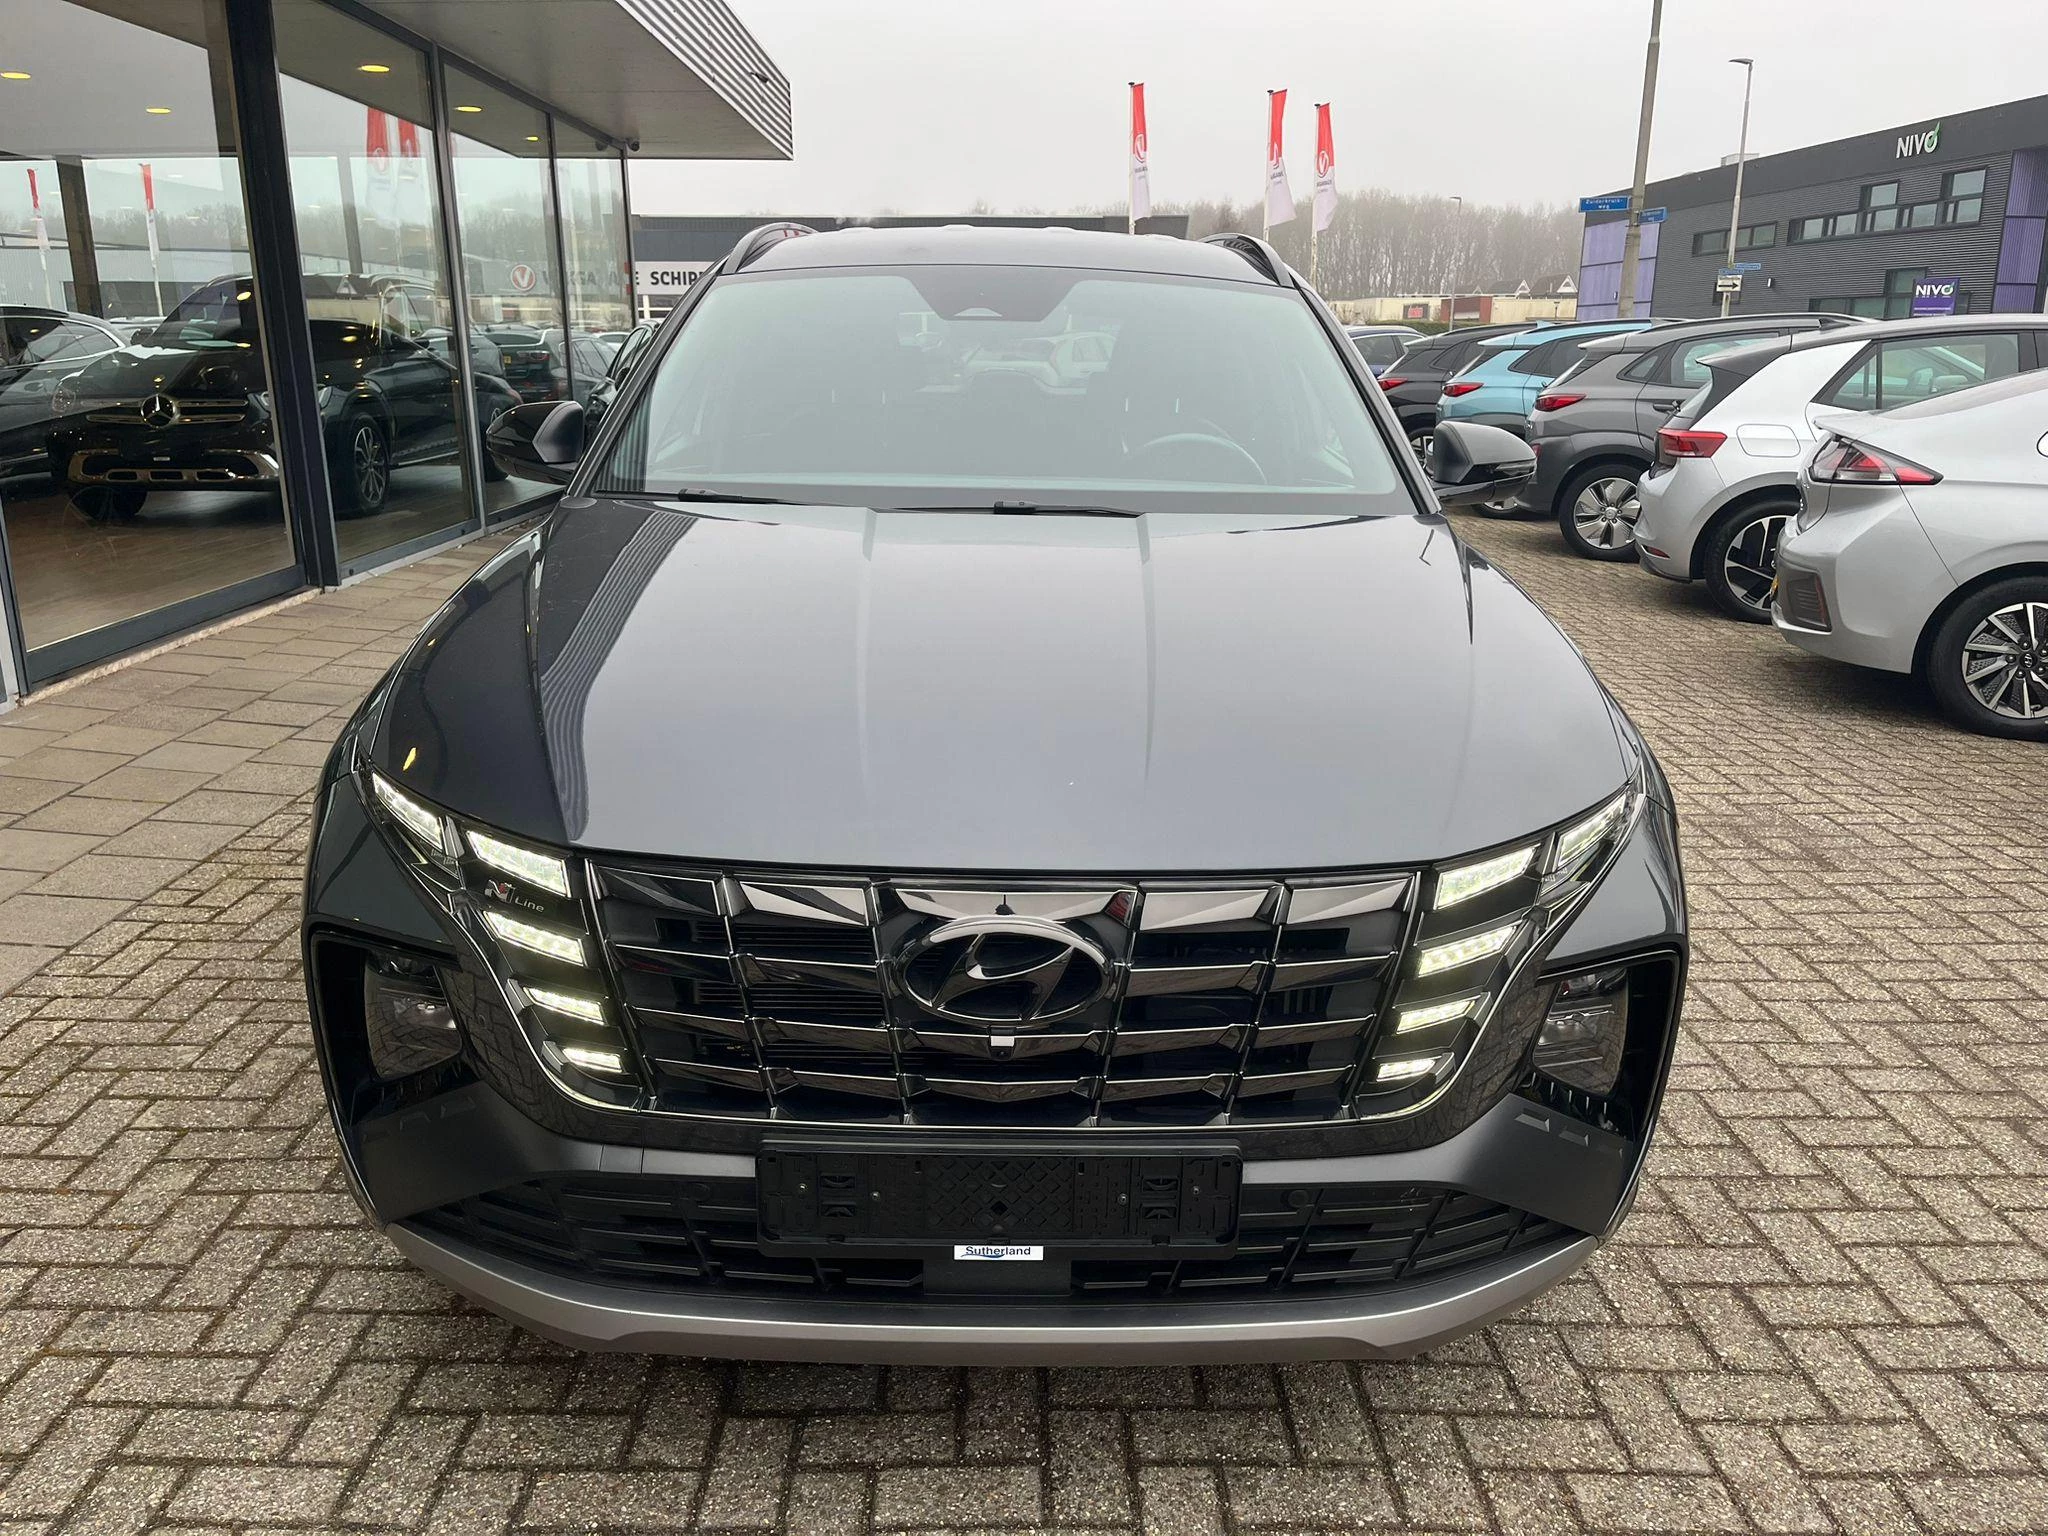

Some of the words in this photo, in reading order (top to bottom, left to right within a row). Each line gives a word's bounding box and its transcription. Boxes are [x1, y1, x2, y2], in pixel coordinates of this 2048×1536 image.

[1896, 128, 1939, 159] NIVO
[1915, 284, 1954, 296] NIVO
[515, 896, 545, 913] Line
[965, 1245, 1031, 1256] Sutherland
